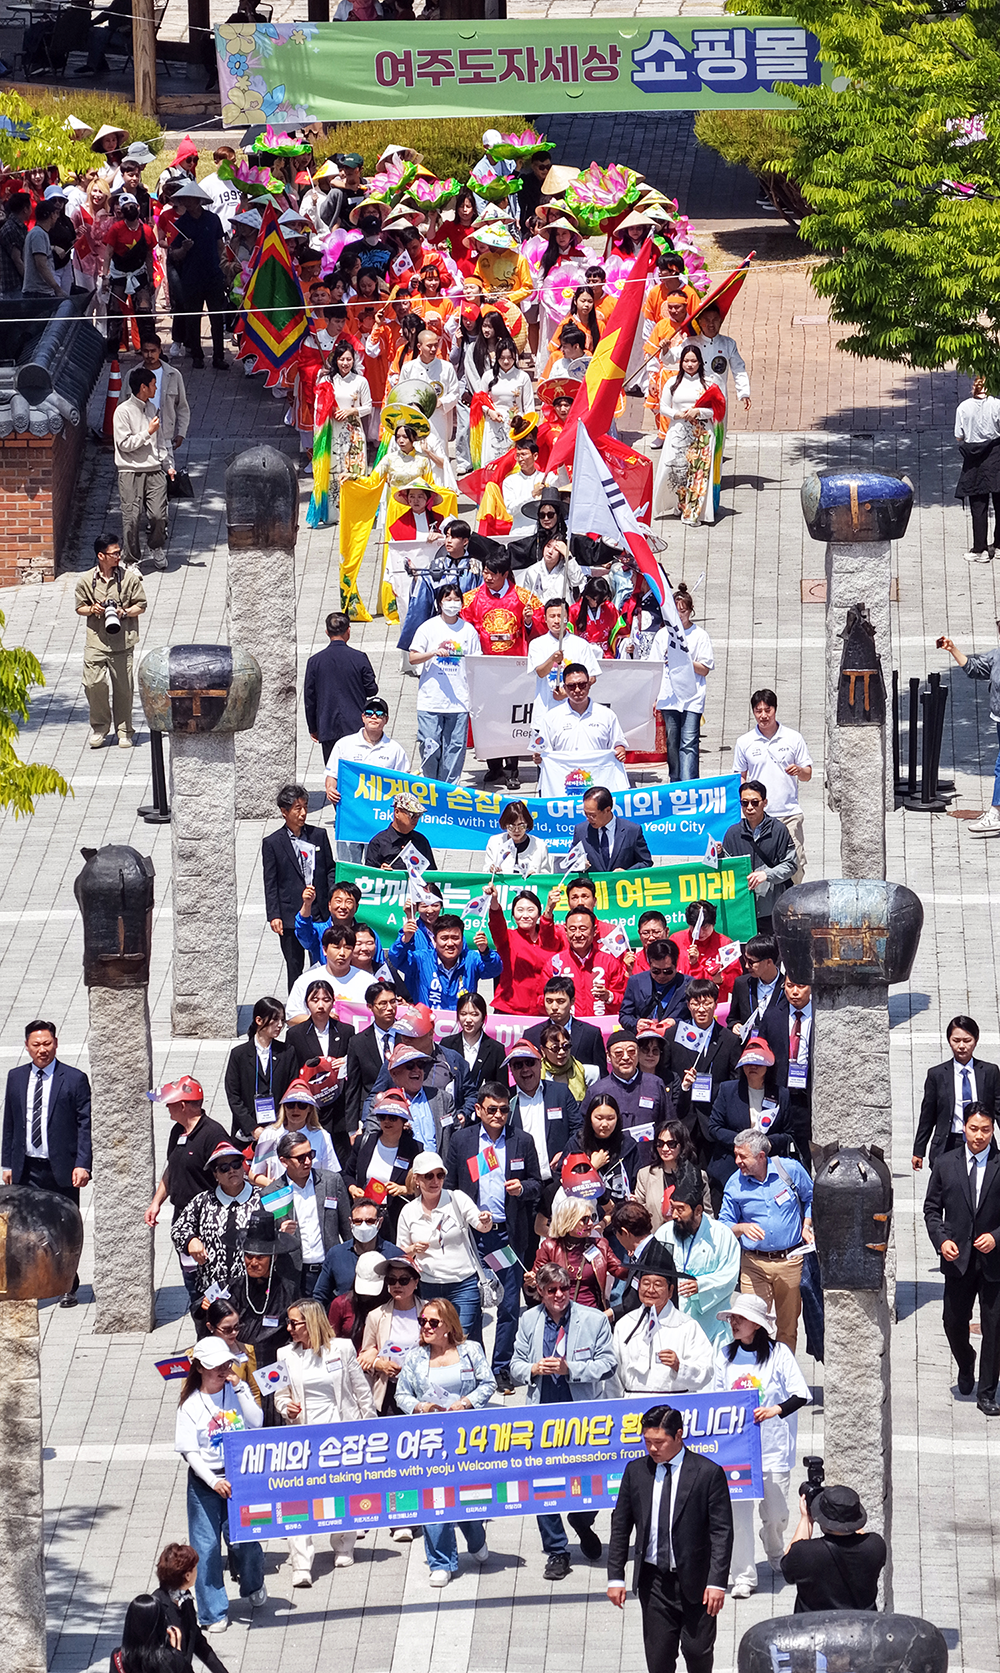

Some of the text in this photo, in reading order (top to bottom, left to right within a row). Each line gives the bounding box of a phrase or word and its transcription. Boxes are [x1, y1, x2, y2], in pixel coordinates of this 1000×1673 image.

[375, 27, 814, 88] 여주도자세상 쇼핑몰
[511, 702, 534, 724] 대
[512, 728, 533, 739] (Rep
[354, 773, 439, 807] 세계와
[446, 786, 539, 820] 손잡,
[669, 786, 727, 816] 함께
[372, 807, 395, 822] Tak
[457, 816, 486, 829] with
[488, 818, 501, 829] th
[532, 822, 552, 834] rld,
[556, 823, 576, 837] tog
[679, 819, 706, 835] City
[616, 877, 672, 908] 여는
[678, 869, 736, 904] 미래
[386, 912, 397, 925] A
[591, 966, 606, 985] 2
[240, 1405, 746, 1475] 세계와 손잡은 여주, 14개국 대사단 환니다!
[268, 1475, 304, 1491] (World
[306, 1473, 327, 1486] and
[328, 1471, 362, 1484] taking
[364, 1467, 397, 1480] hands
[399, 1464, 424, 1477] with
[426, 1461, 455, 1478] yeoju
[457, 1459, 509, 1472] Welcome
[511, 1457, 522, 1468] to
[525, 1455, 543, 1467] the
[545, 1450, 618, 1466] ambassadors
[620, 1448, 646, 1460] from
